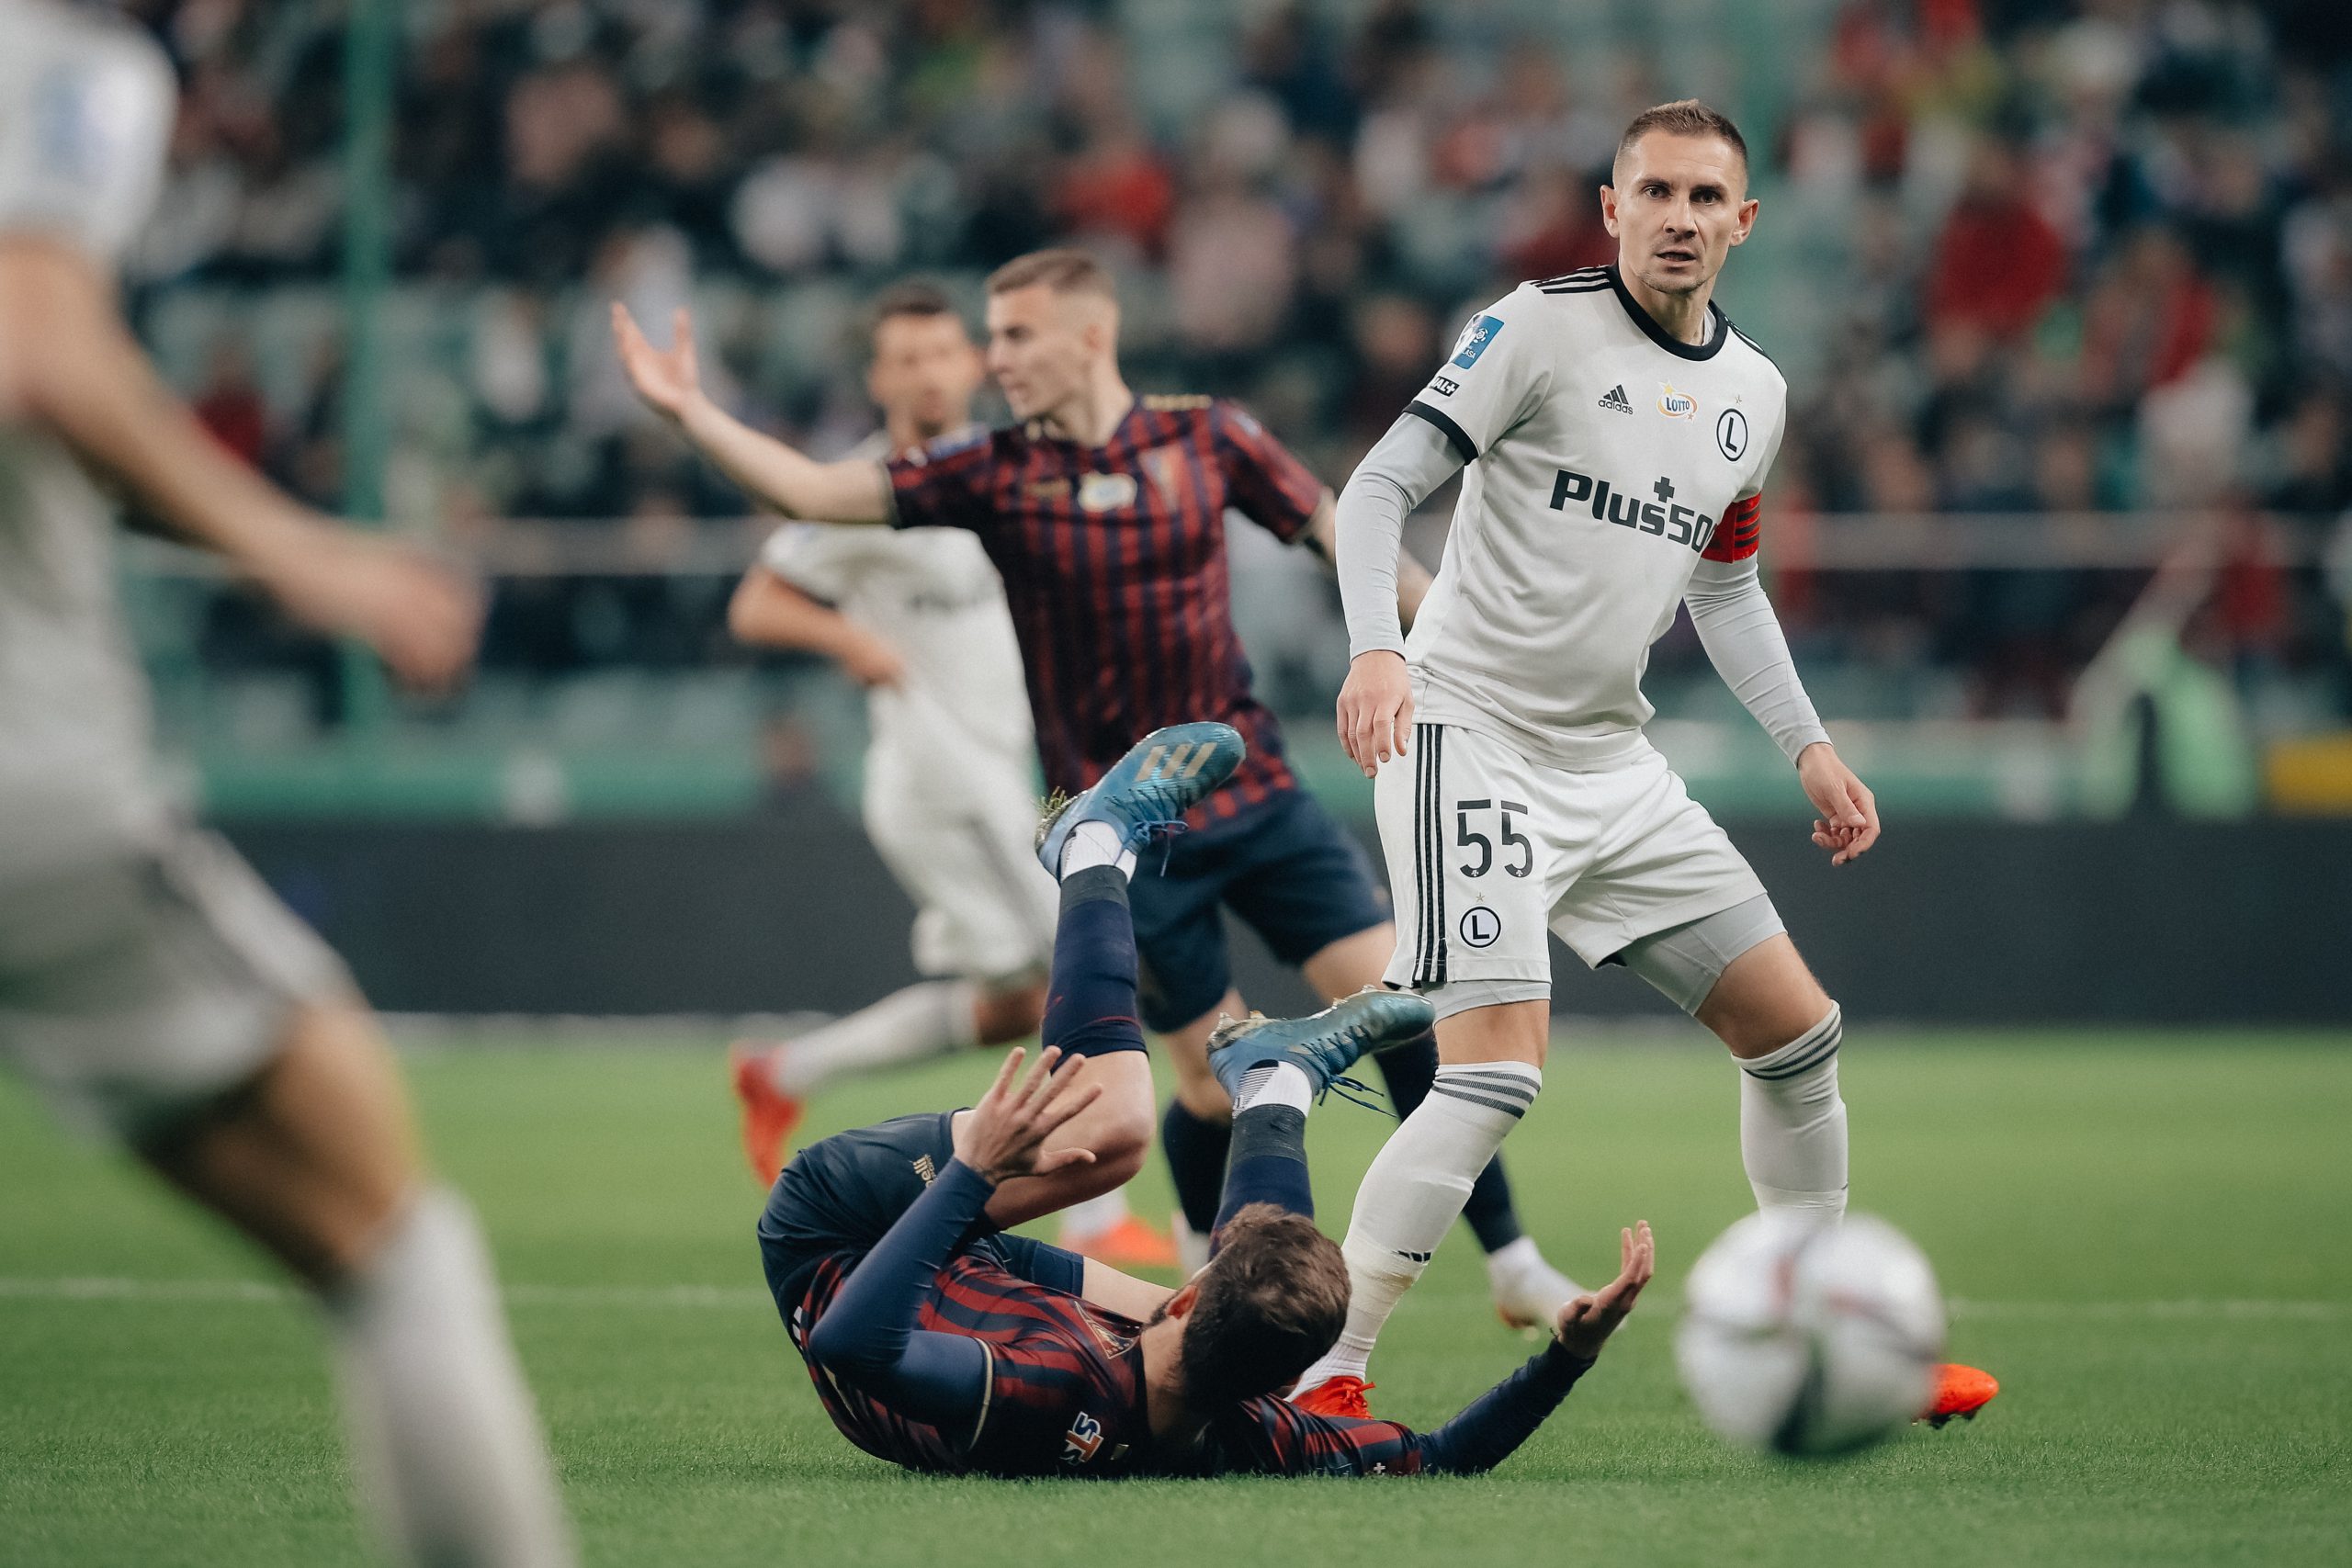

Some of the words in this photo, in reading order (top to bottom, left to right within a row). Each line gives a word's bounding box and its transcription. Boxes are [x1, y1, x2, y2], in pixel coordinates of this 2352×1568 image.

[1598, 398, 1634, 415] adidas
[1666, 397, 1690, 412] LOTTO
[1549, 468, 1718, 554] Plus50
[1457, 799, 1533, 878] 55
